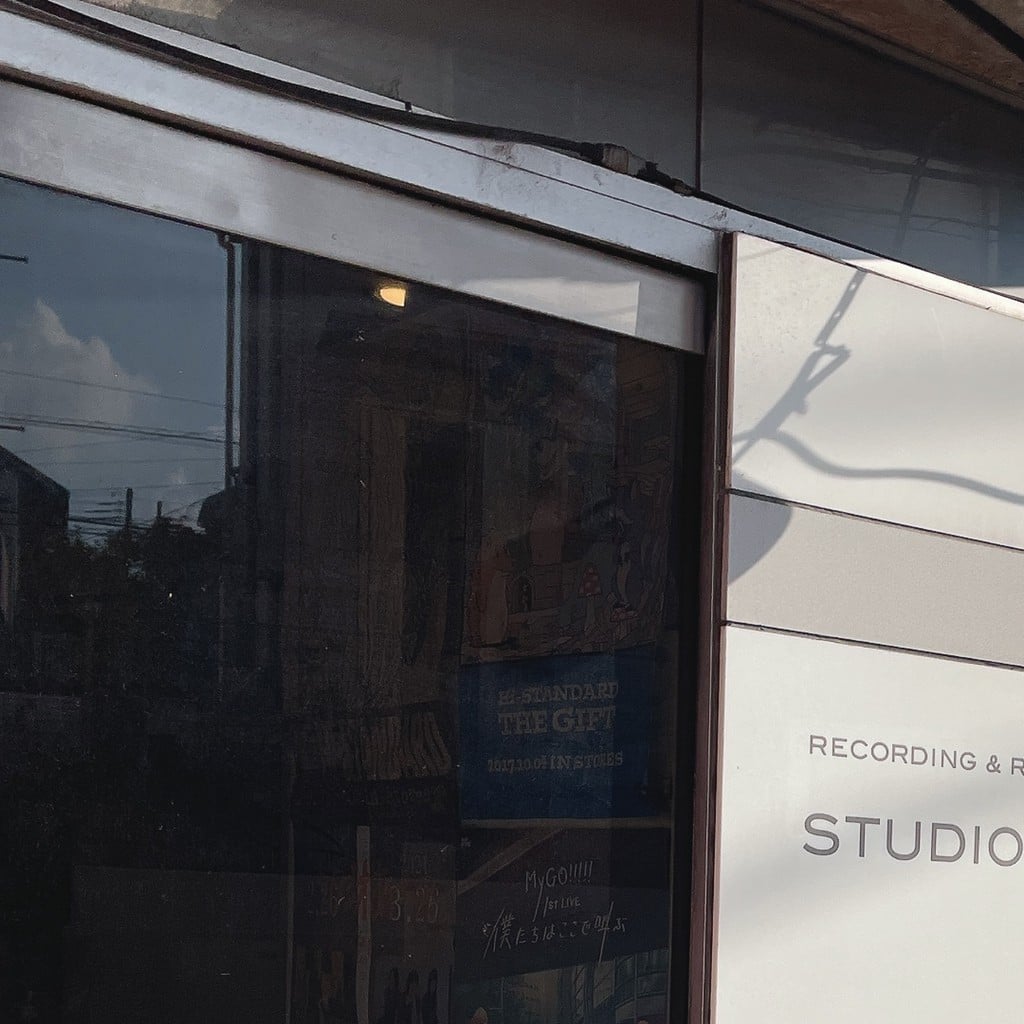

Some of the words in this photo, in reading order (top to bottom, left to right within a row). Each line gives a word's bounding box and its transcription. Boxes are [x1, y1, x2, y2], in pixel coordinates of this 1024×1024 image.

[498, 710, 548, 735] THE
[552, 706, 617, 733] GIFT
[549, 755, 571, 771] IN
[808, 734, 977, 771] RECORDING
[985, 754, 1002, 774] &
[802, 812, 1024, 867] STUDIO
[560, 896, 581, 910] LIVE
